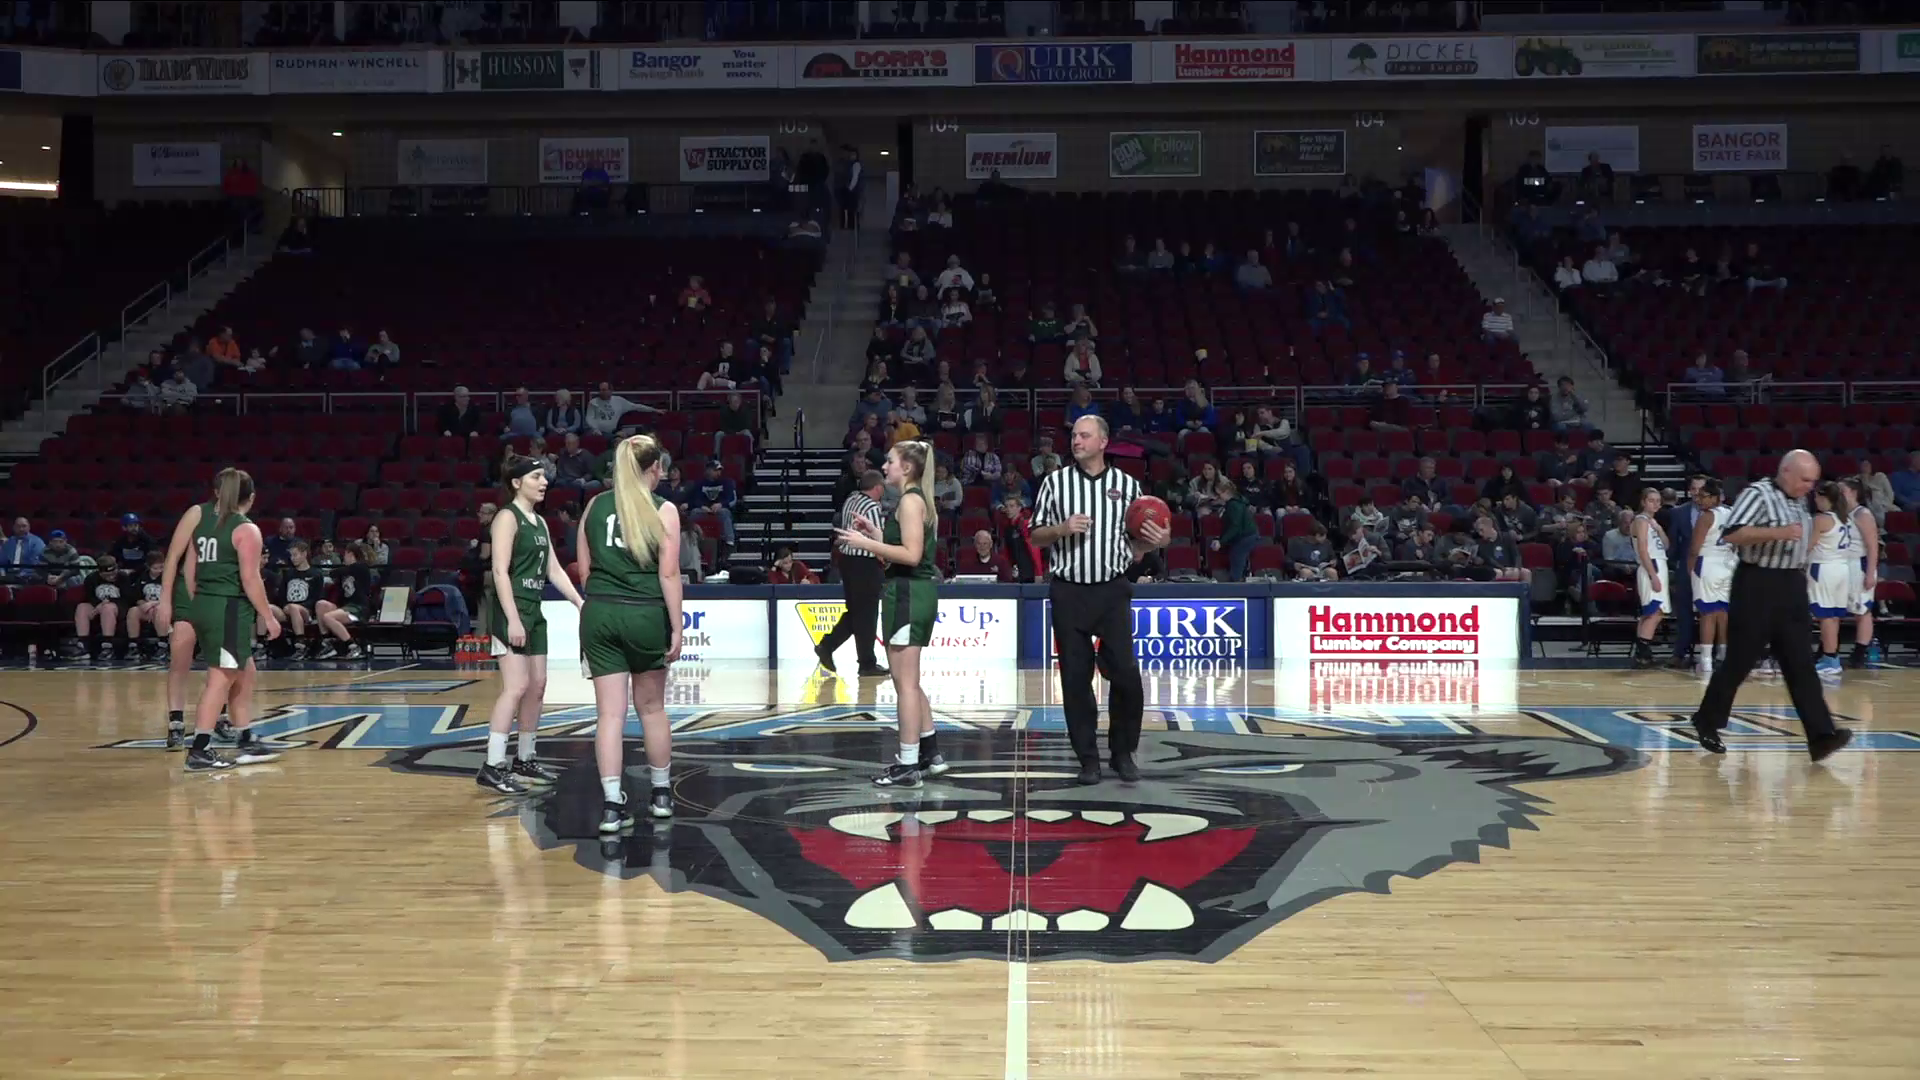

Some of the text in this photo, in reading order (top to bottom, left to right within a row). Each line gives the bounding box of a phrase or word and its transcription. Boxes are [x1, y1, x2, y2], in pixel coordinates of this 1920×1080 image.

[732, 50, 756, 59] You
[855, 50, 946, 67] DORR'S
[1175, 43, 1294, 63] Hammond
[1387, 43, 1478, 60] DICKEL
[275, 57, 420, 69] RUDMAN WINCHELL
[487, 56, 557, 76] HUSSON
[631, 52, 702, 72] Bangor
[722, 60, 766, 69] matter
[1029, 68, 1116, 80] AUTO GROUP
[1178, 65, 1291, 78] Lumber Company
[930, 116, 959, 133] 104
[1354, 112, 1384, 127] 104
[1153, 135, 1194, 153] Follow
[1697, 132, 1780, 148] BANGOR
[707, 147, 767, 158] TRACTOR
[970, 147, 1052, 166] PREMIUM
[1699, 150, 1781, 161] STATE FAIR
[707, 159, 751, 171] SUPPLY
[196, 536, 217, 563] 30
[958, 606, 1000, 630] Up.
[1130, 606, 1242, 637] IRK
[1308, 605, 1479, 633] Hammond
[680, 632, 711, 647] ank
[930, 631, 989, 649] cuses!
[1132, 638, 1242, 657] TO GROUP
[1312, 636, 1475, 655] Lumber Company
